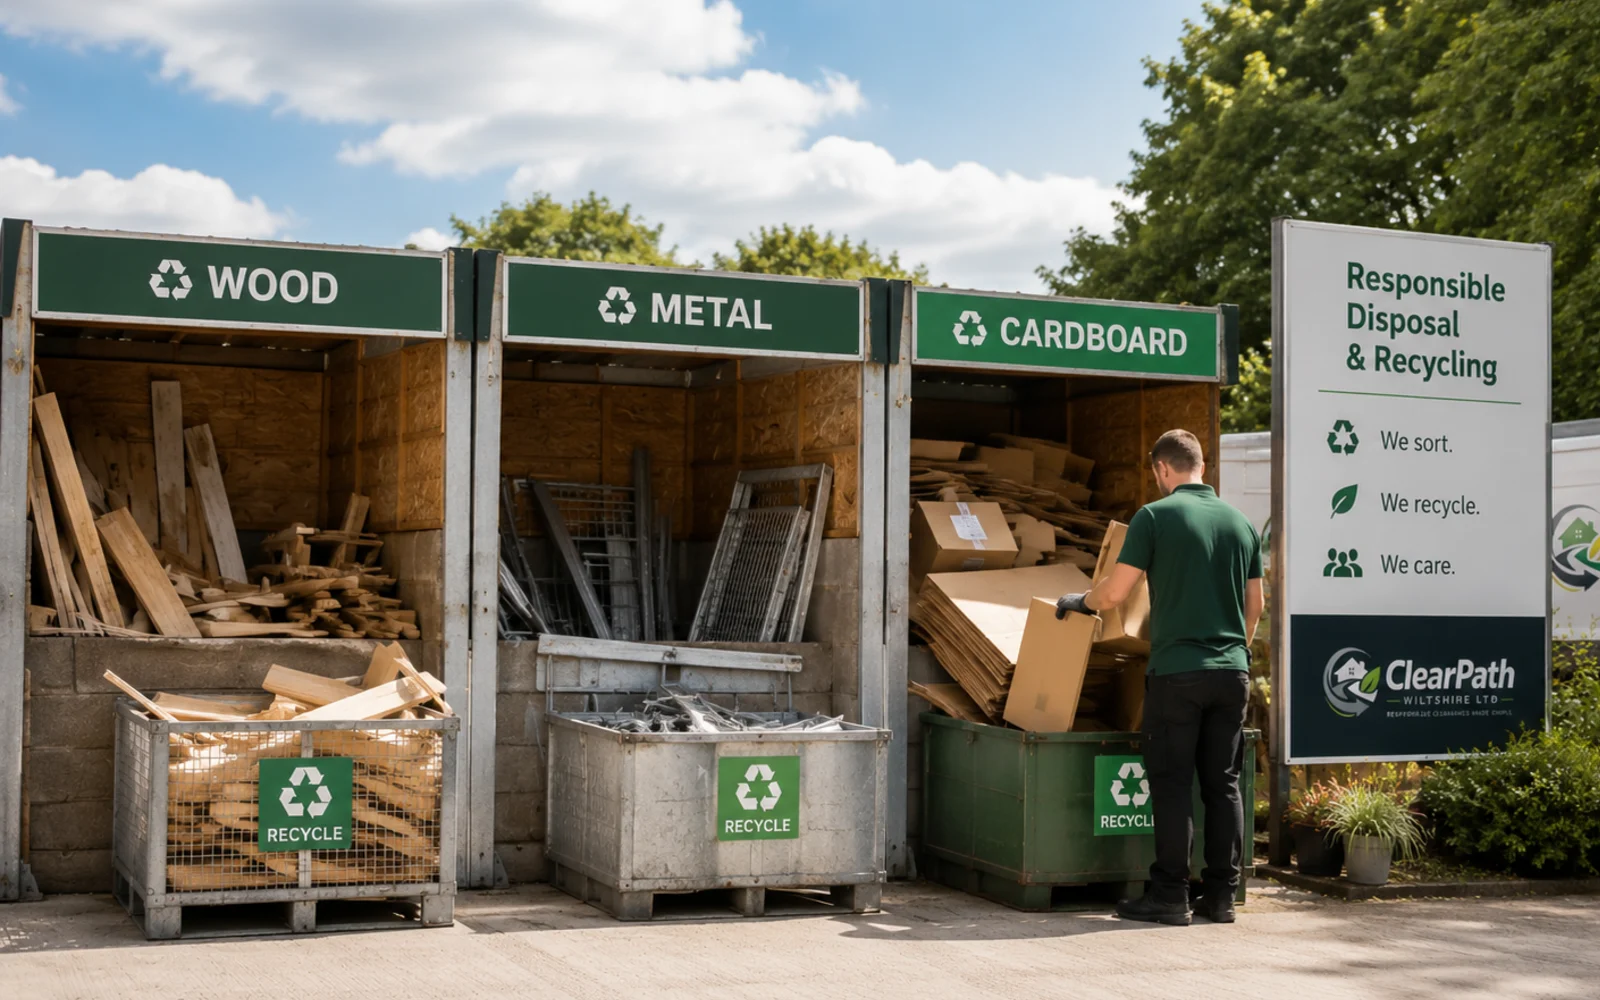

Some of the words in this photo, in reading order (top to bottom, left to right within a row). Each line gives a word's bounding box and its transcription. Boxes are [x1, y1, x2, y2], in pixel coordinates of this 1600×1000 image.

[207, 265, 338, 305] WOOD
[1348, 261, 1505, 302] Responsible
[651, 292, 773, 331] METAL
[1348, 303, 1460, 339] Disposal
[1000, 316, 1188, 357] CARDBOARD
[1347, 343, 1366, 371] &
[1375, 345, 1498, 387] Recycling
[1380, 430, 1409, 450] We
[1414, 435, 1453, 453] sort.
[1380, 492, 1409, 512] We
[1414, 495, 1480, 519] recycle.
[1380, 554, 1409, 574] We
[1413, 559, 1456, 575] care.
[1386, 658, 1515, 691] ClearPath
[1403, 695, 1470, 705] WILTSHIRE
[1475, 695, 1498, 704] LTD
[267, 826, 343, 843] RECYCLE
[725, 818, 791, 833] RECYCLE
